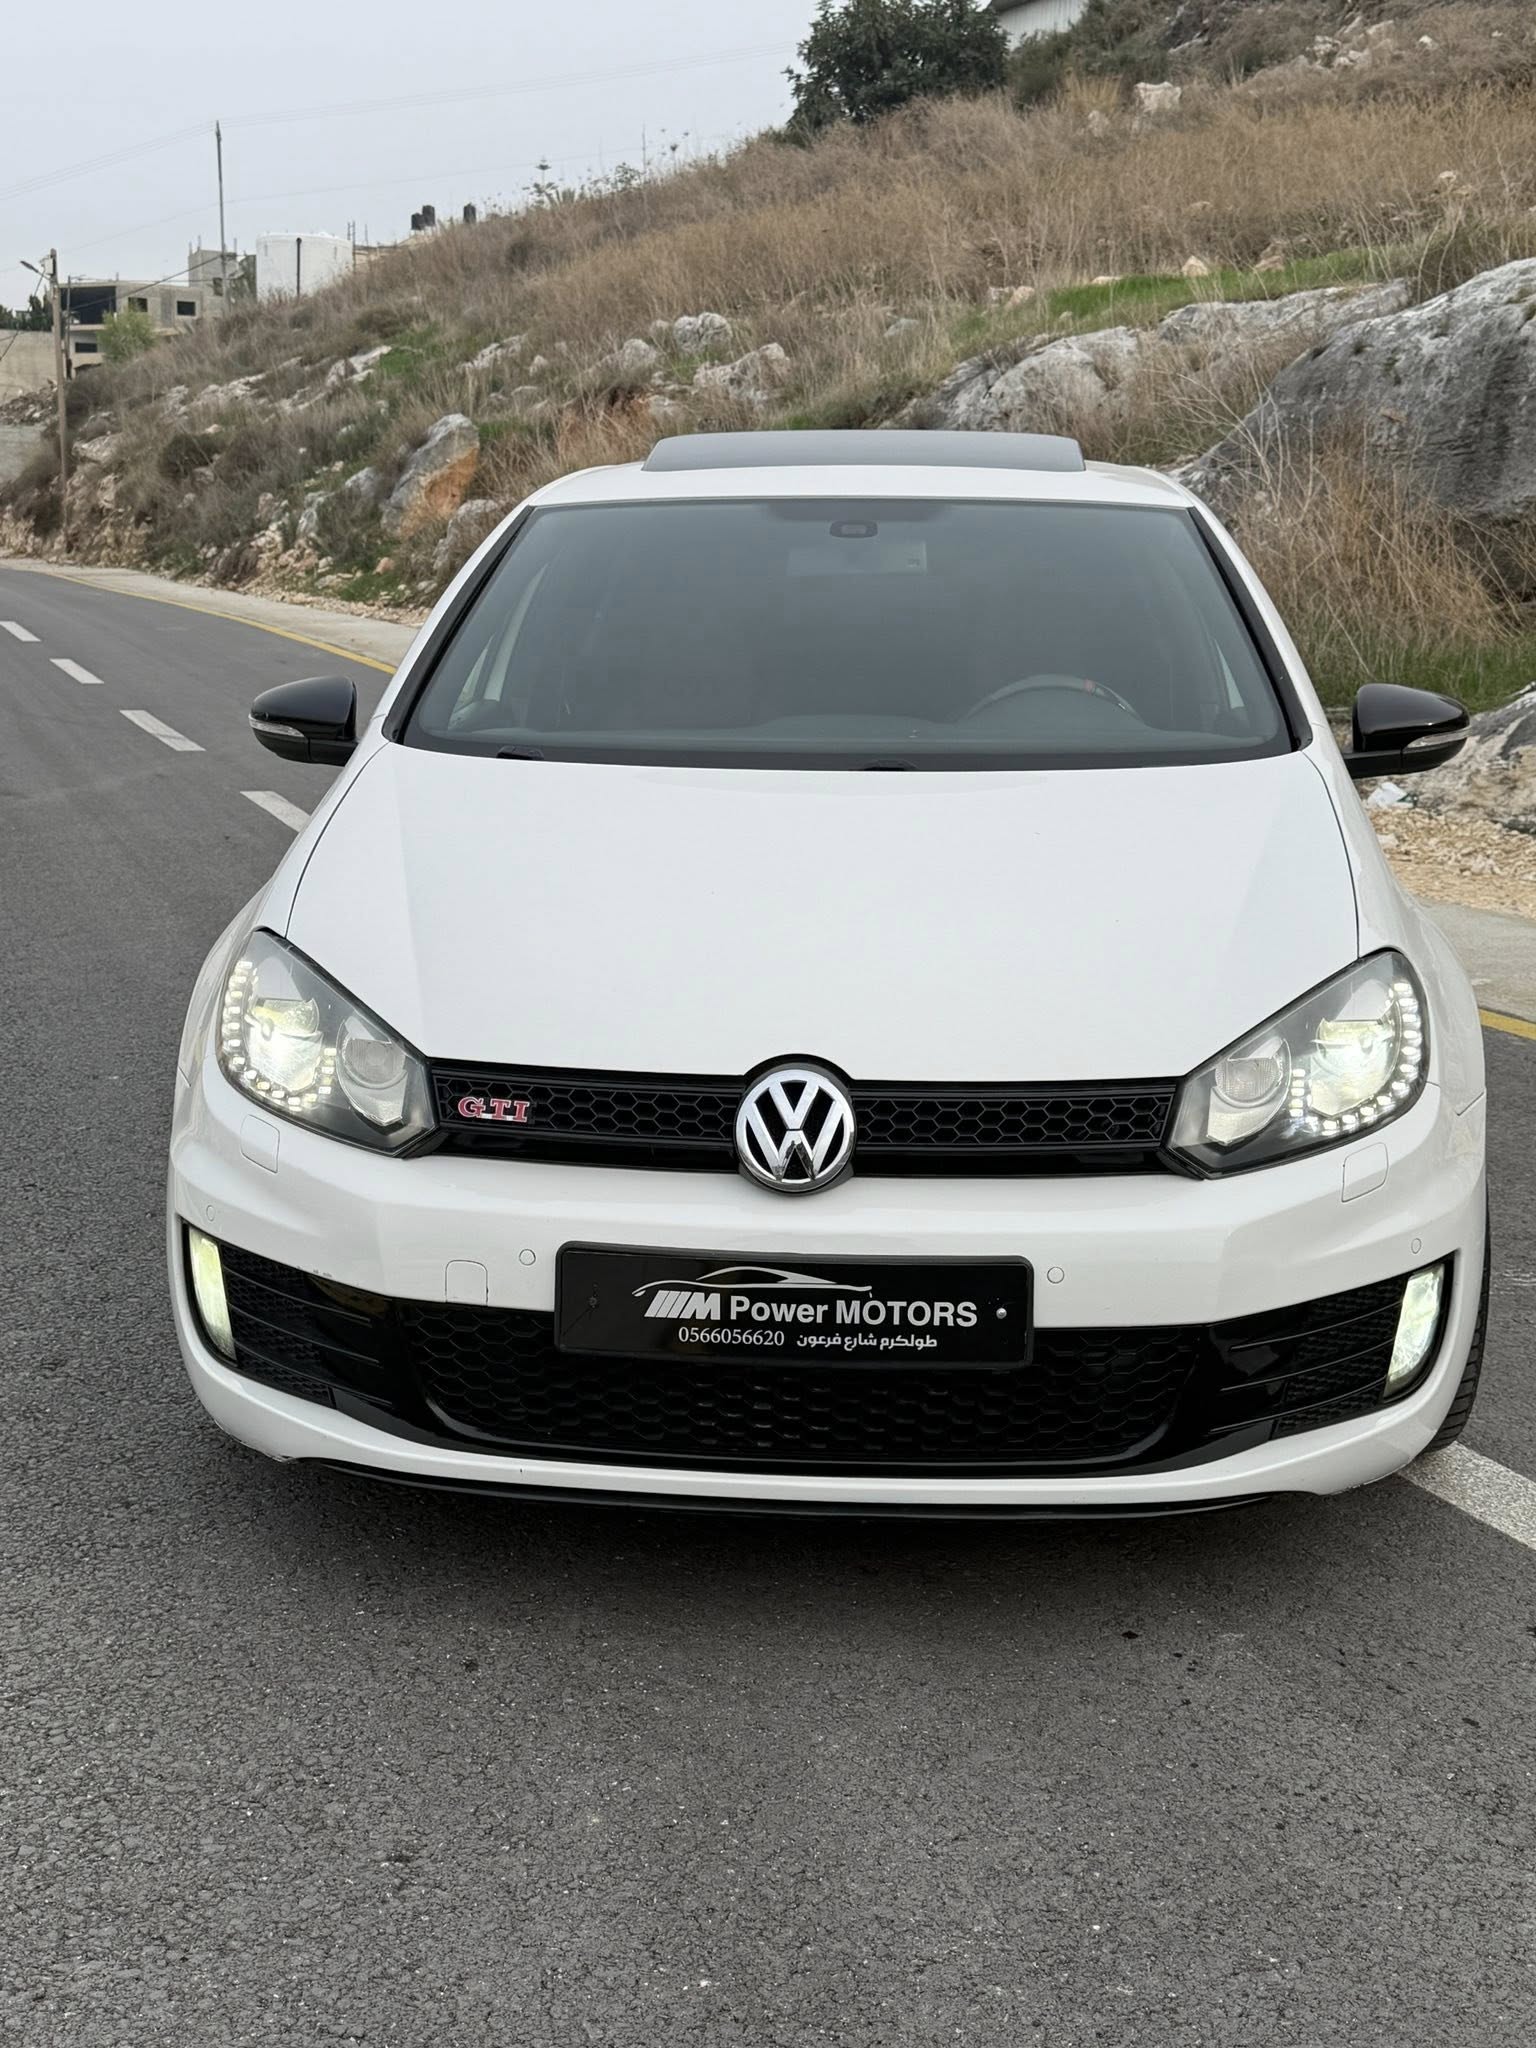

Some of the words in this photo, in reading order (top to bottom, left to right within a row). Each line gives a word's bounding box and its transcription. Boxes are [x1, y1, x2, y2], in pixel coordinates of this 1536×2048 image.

[457, 1096, 530, 1123] GTI
[743, 1076, 847, 1184] VW
[730, 1295, 829, 1324] Power
[835, 1299, 978, 1327] MOTORS
[678, 1326, 785, 1346] 0566056620
[796, 1333, 842, 1348] فرعون
[843, 1332, 877, 1351] شارع
[879, 1334, 938, 1350] طولكرم
